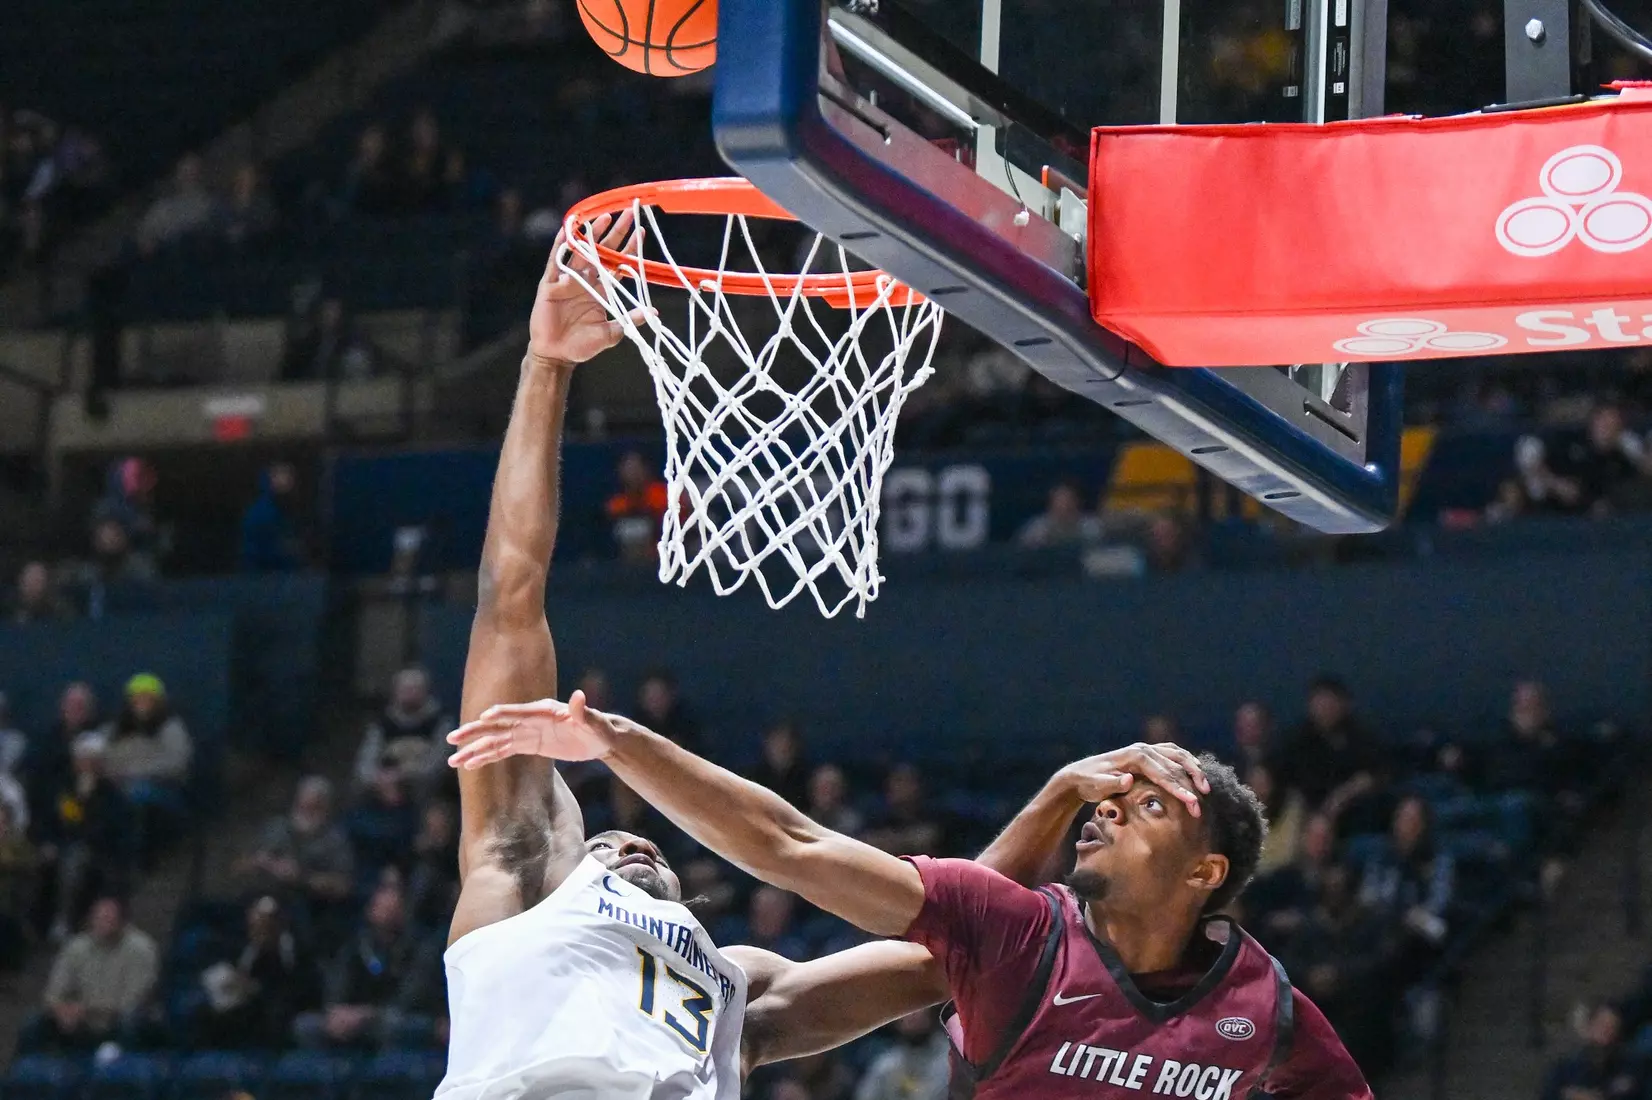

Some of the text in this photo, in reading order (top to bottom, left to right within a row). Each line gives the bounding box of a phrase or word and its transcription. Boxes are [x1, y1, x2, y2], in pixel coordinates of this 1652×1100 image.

[1515, 308, 1652, 346] St
[882, 467, 990, 550] GO
[636, 944, 714, 1055] 13
[1223, 1023, 1247, 1034] OVC
[1050, 1041, 1243, 1100] LITTLE ROCK
